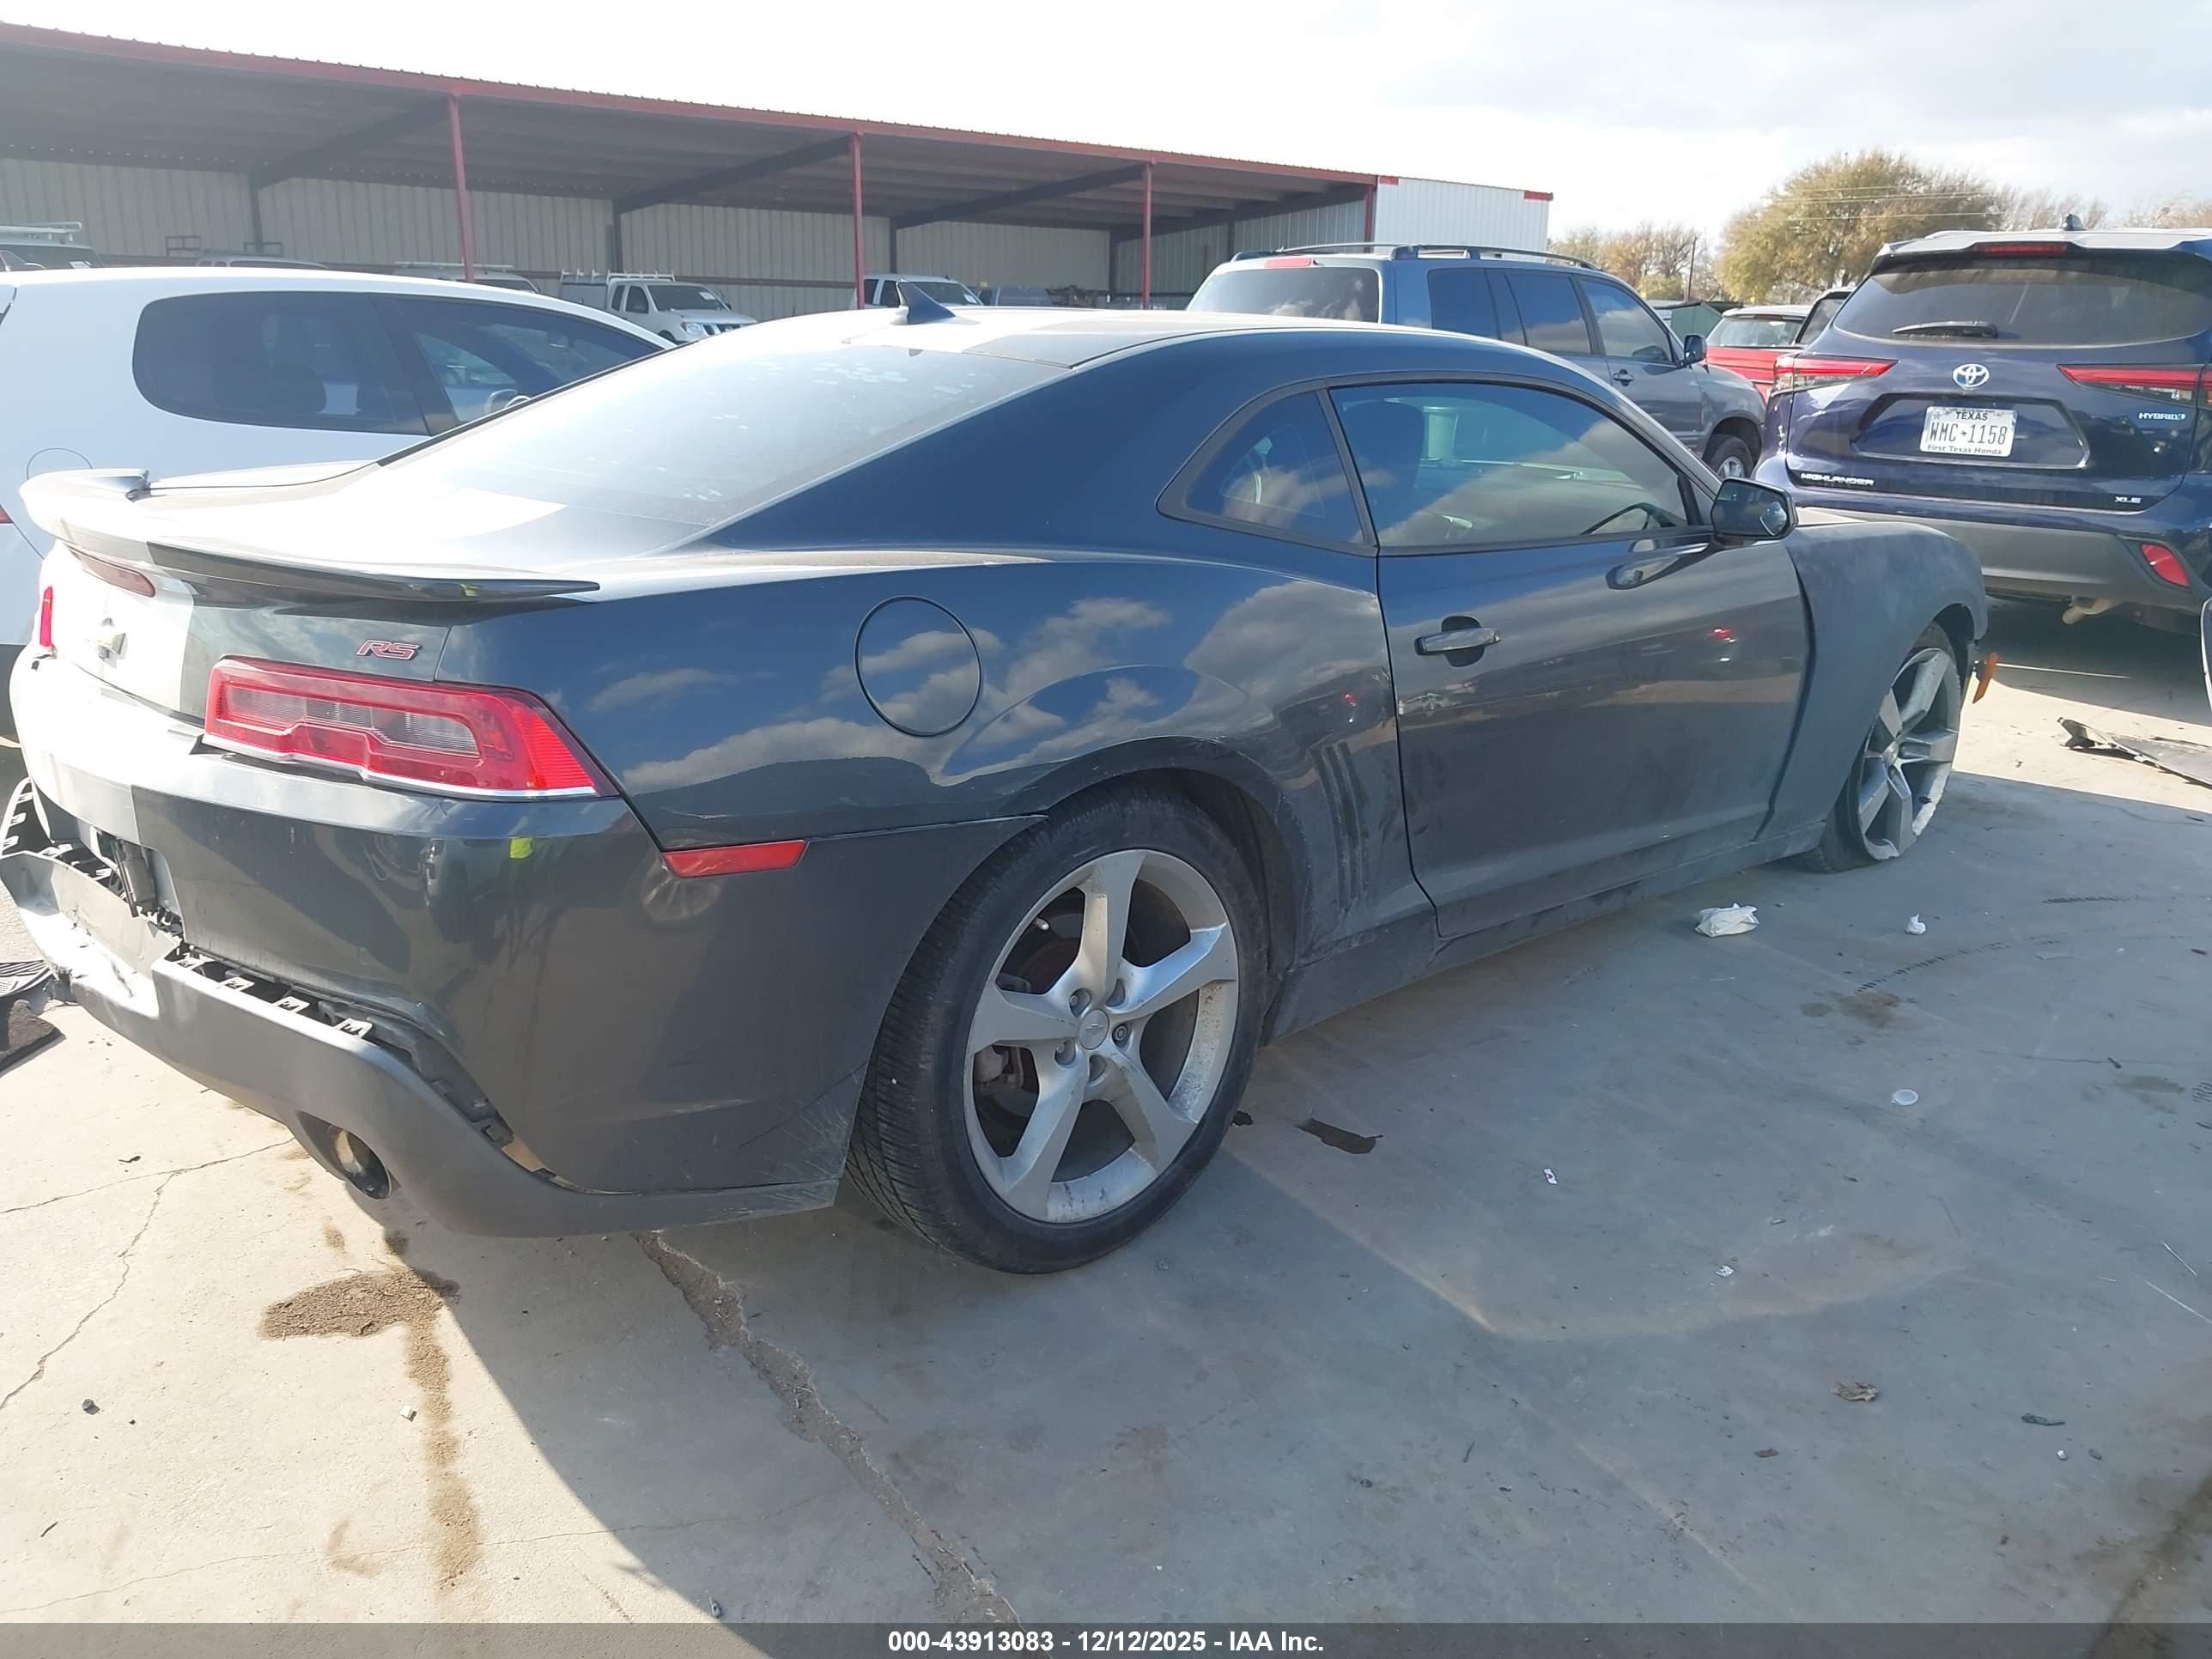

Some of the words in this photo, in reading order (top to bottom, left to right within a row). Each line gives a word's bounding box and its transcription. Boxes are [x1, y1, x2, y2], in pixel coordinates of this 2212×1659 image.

[1955, 411, 1988, 421] TEXAS
[2138, 412, 2179, 421] HYBRID
[1929, 422, 1959, 442] WMC
[1967, 423, 2008, 445] 1158
[1949, 445, 1972, 453] Texas
[1801, 473, 1875, 486] HIGHLANDER
[356, 639, 420, 660] RS
